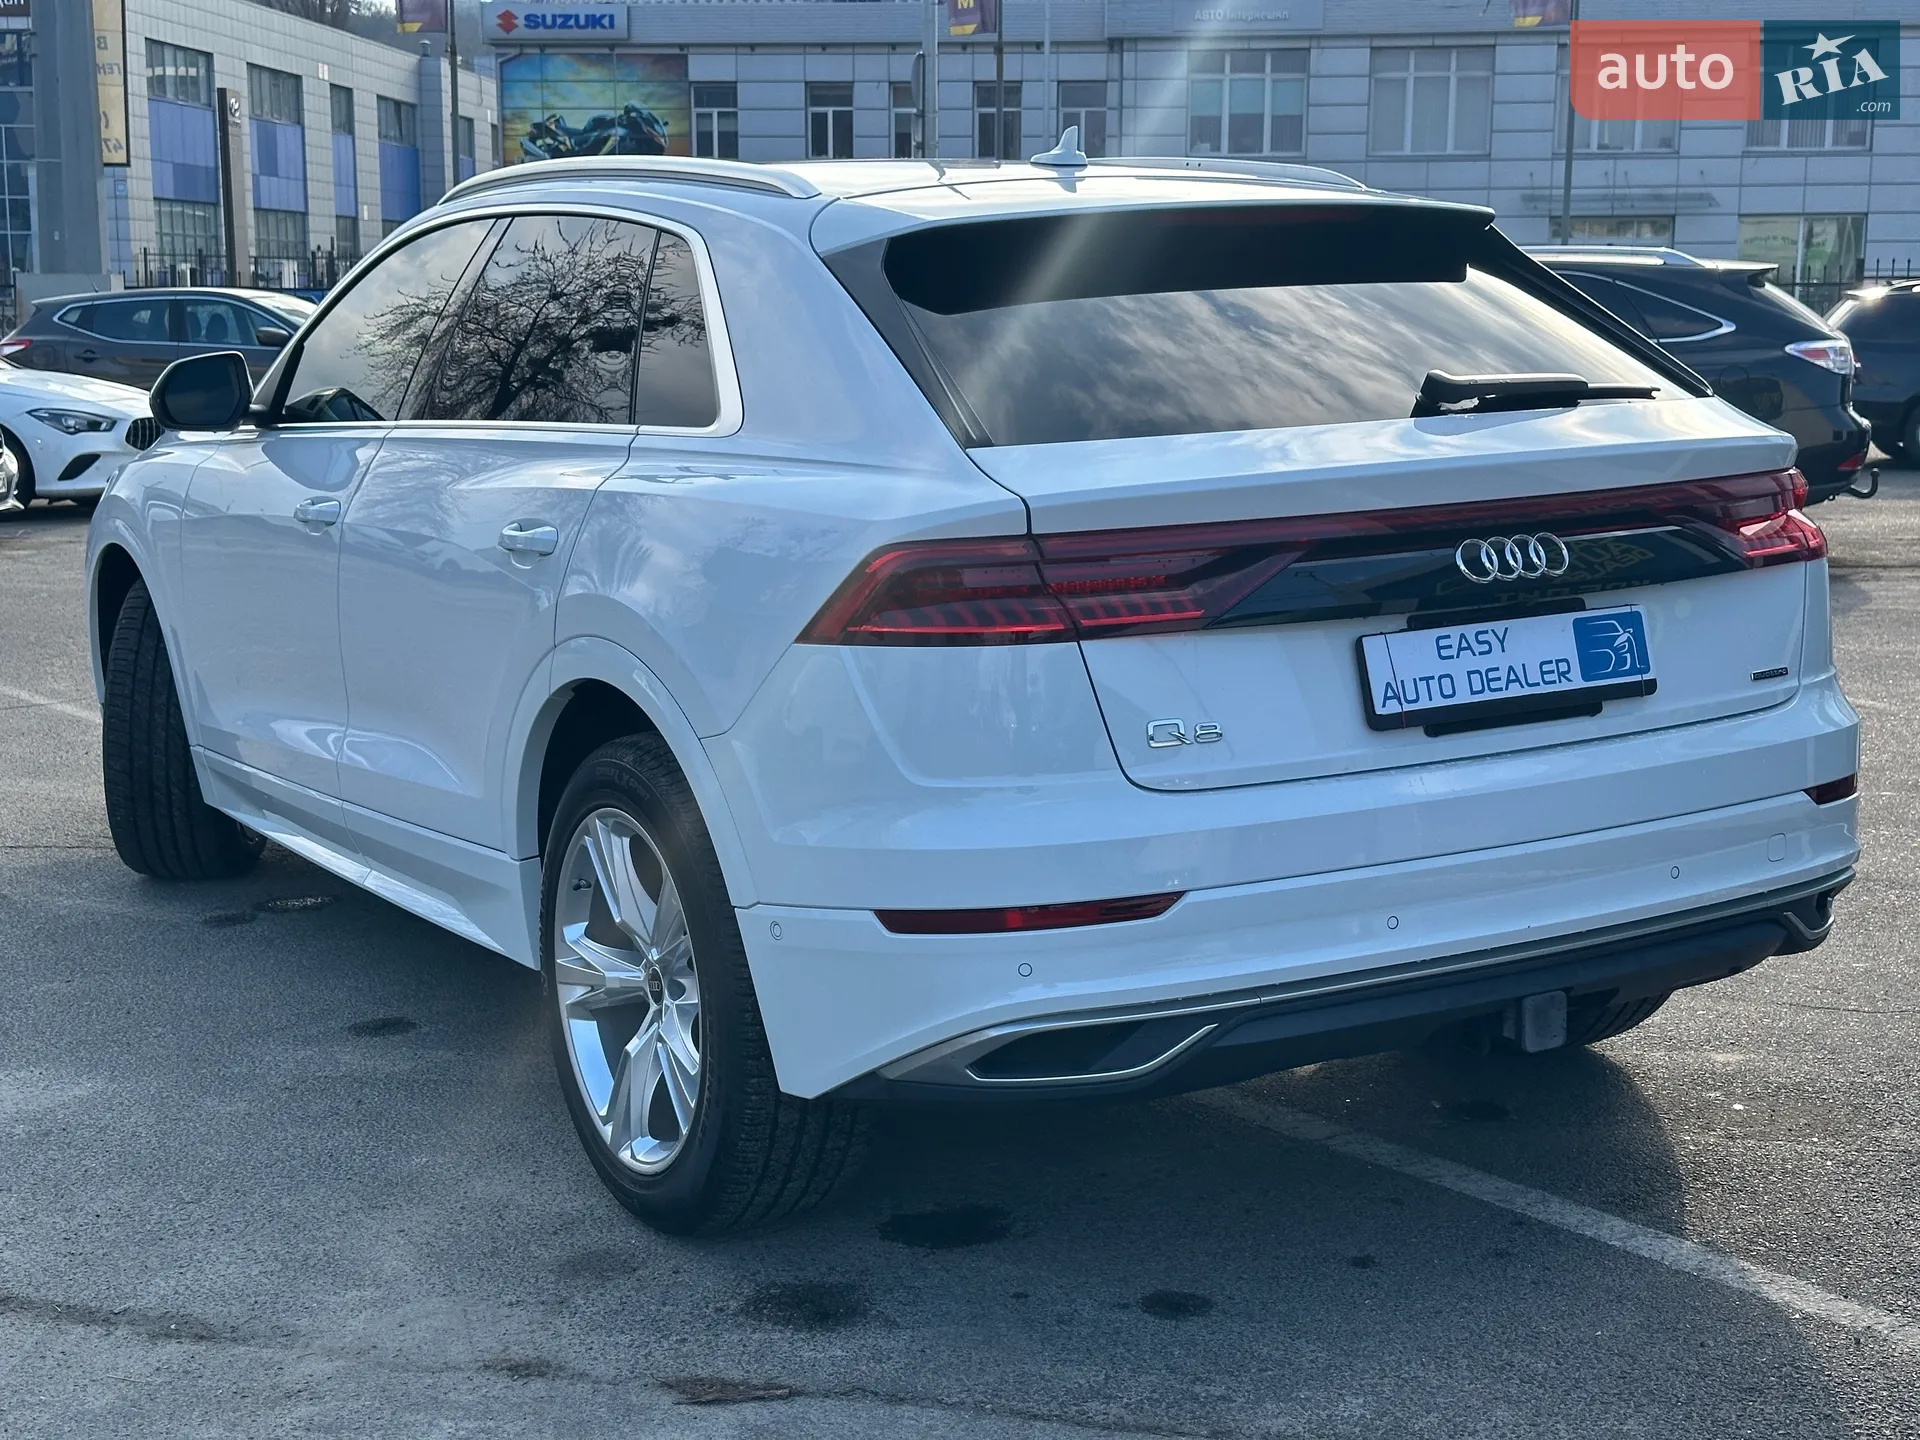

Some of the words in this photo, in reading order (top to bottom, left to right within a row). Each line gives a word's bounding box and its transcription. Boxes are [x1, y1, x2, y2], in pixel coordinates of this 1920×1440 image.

[523, 13, 615, 30] SUZUKI
[1194, 9, 1224, 21] АВТО
[1435, 627, 1509, 661] EASY
[1381, 673, 1457, 709] AUTO
[1466, 657, 1573, 696] DEALER
[1146, 717, 1223, 749] Q8
